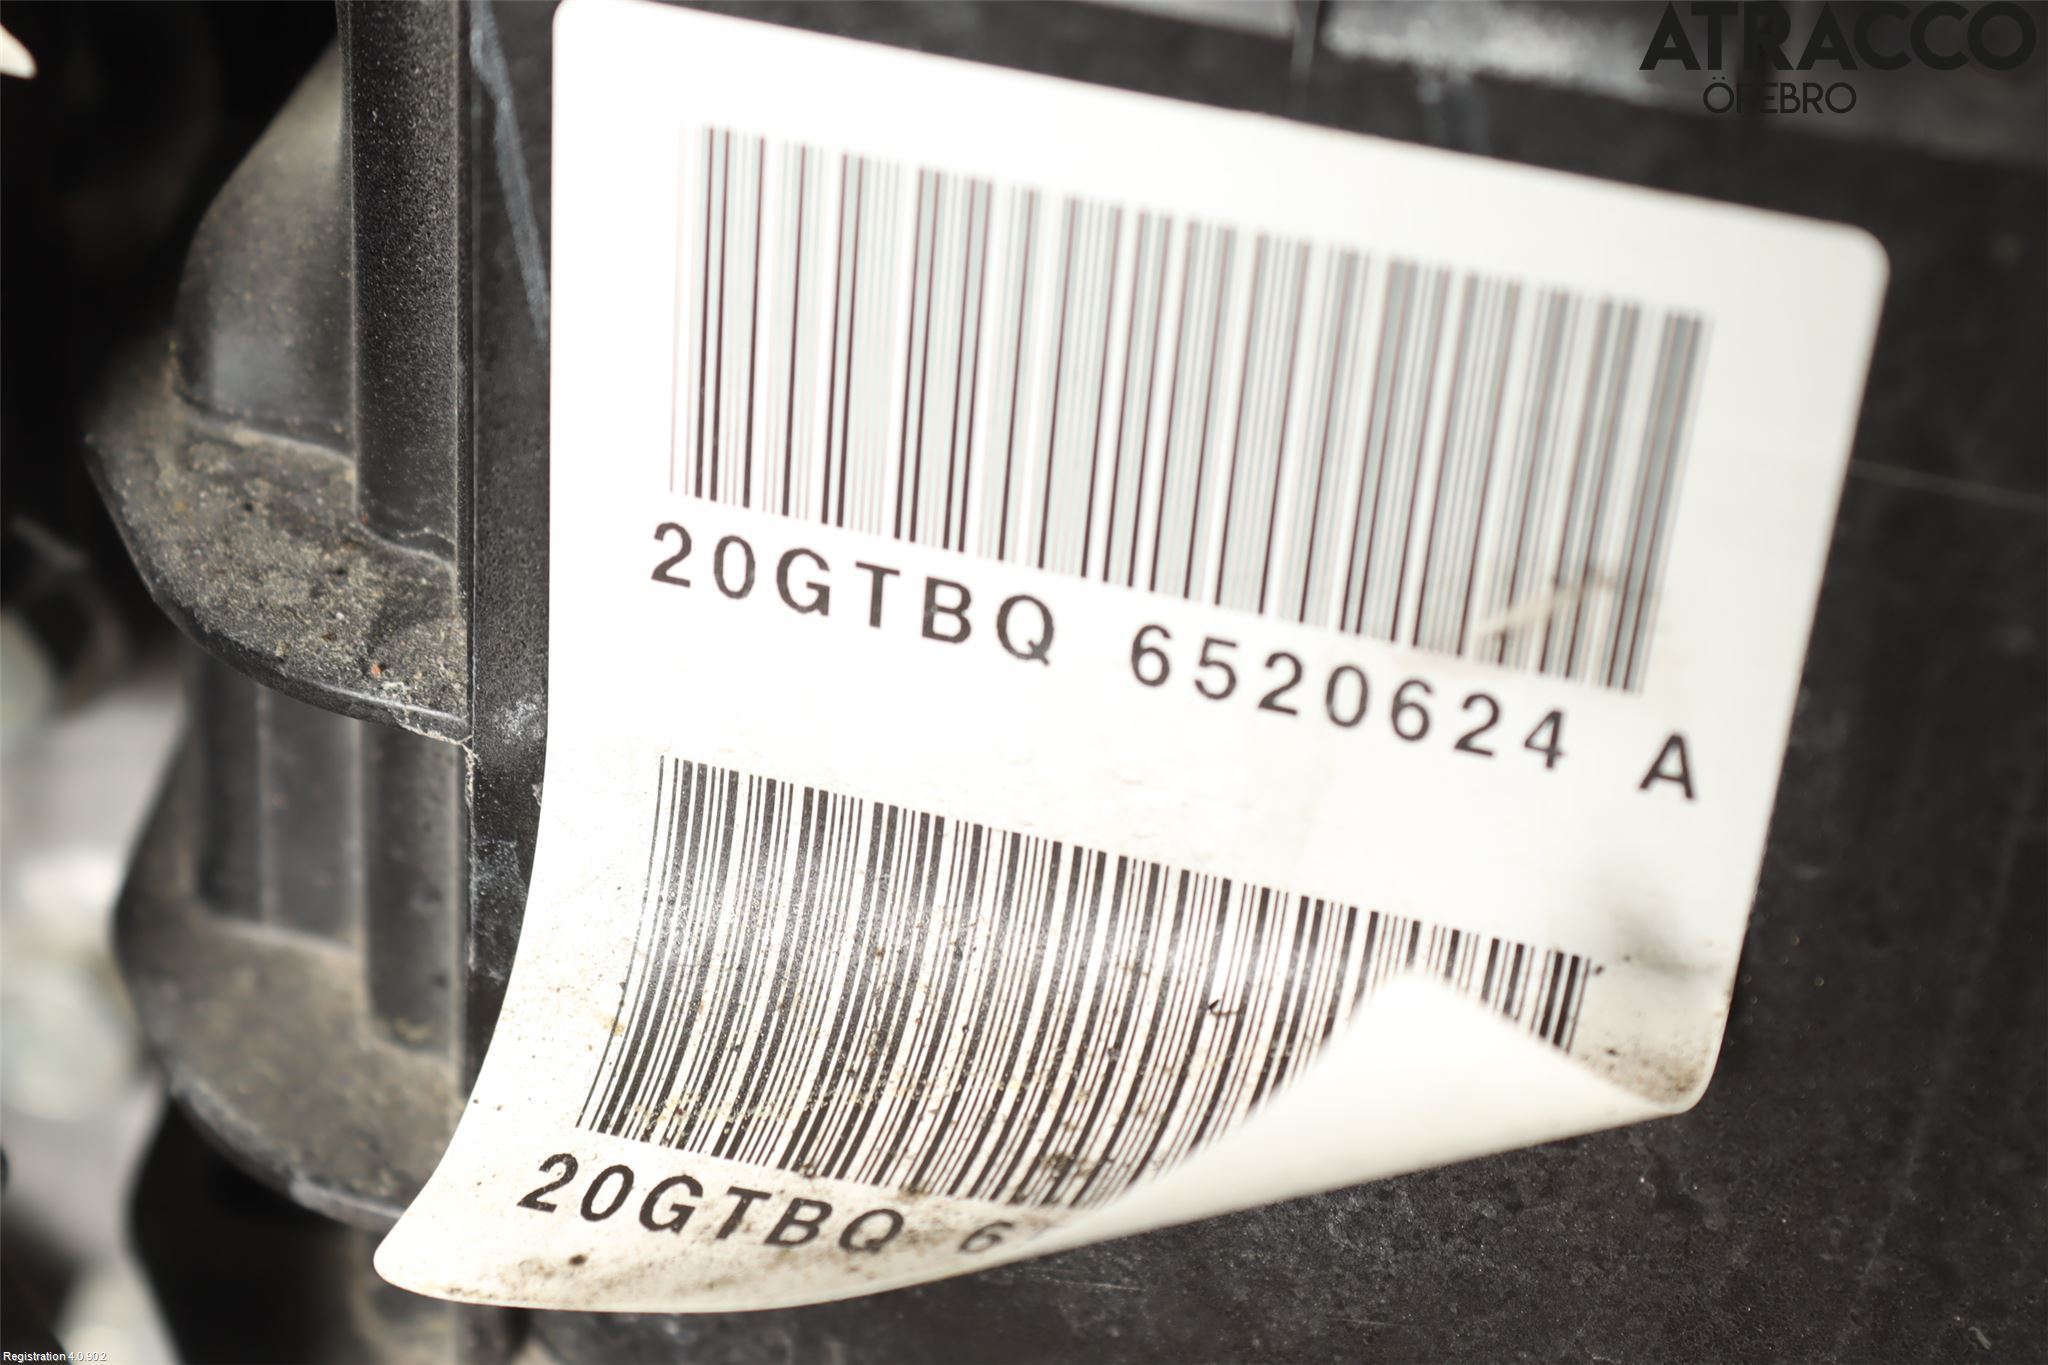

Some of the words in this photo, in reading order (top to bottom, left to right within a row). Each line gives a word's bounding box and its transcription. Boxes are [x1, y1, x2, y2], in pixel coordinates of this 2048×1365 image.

[651, 521, 1055, 667] 20GTBQ
[1130, 624, 1567, 771] 6520624
[1639, 733, 1696, 801] A
[516, 1152, 905, 1254] 20GTBQ
